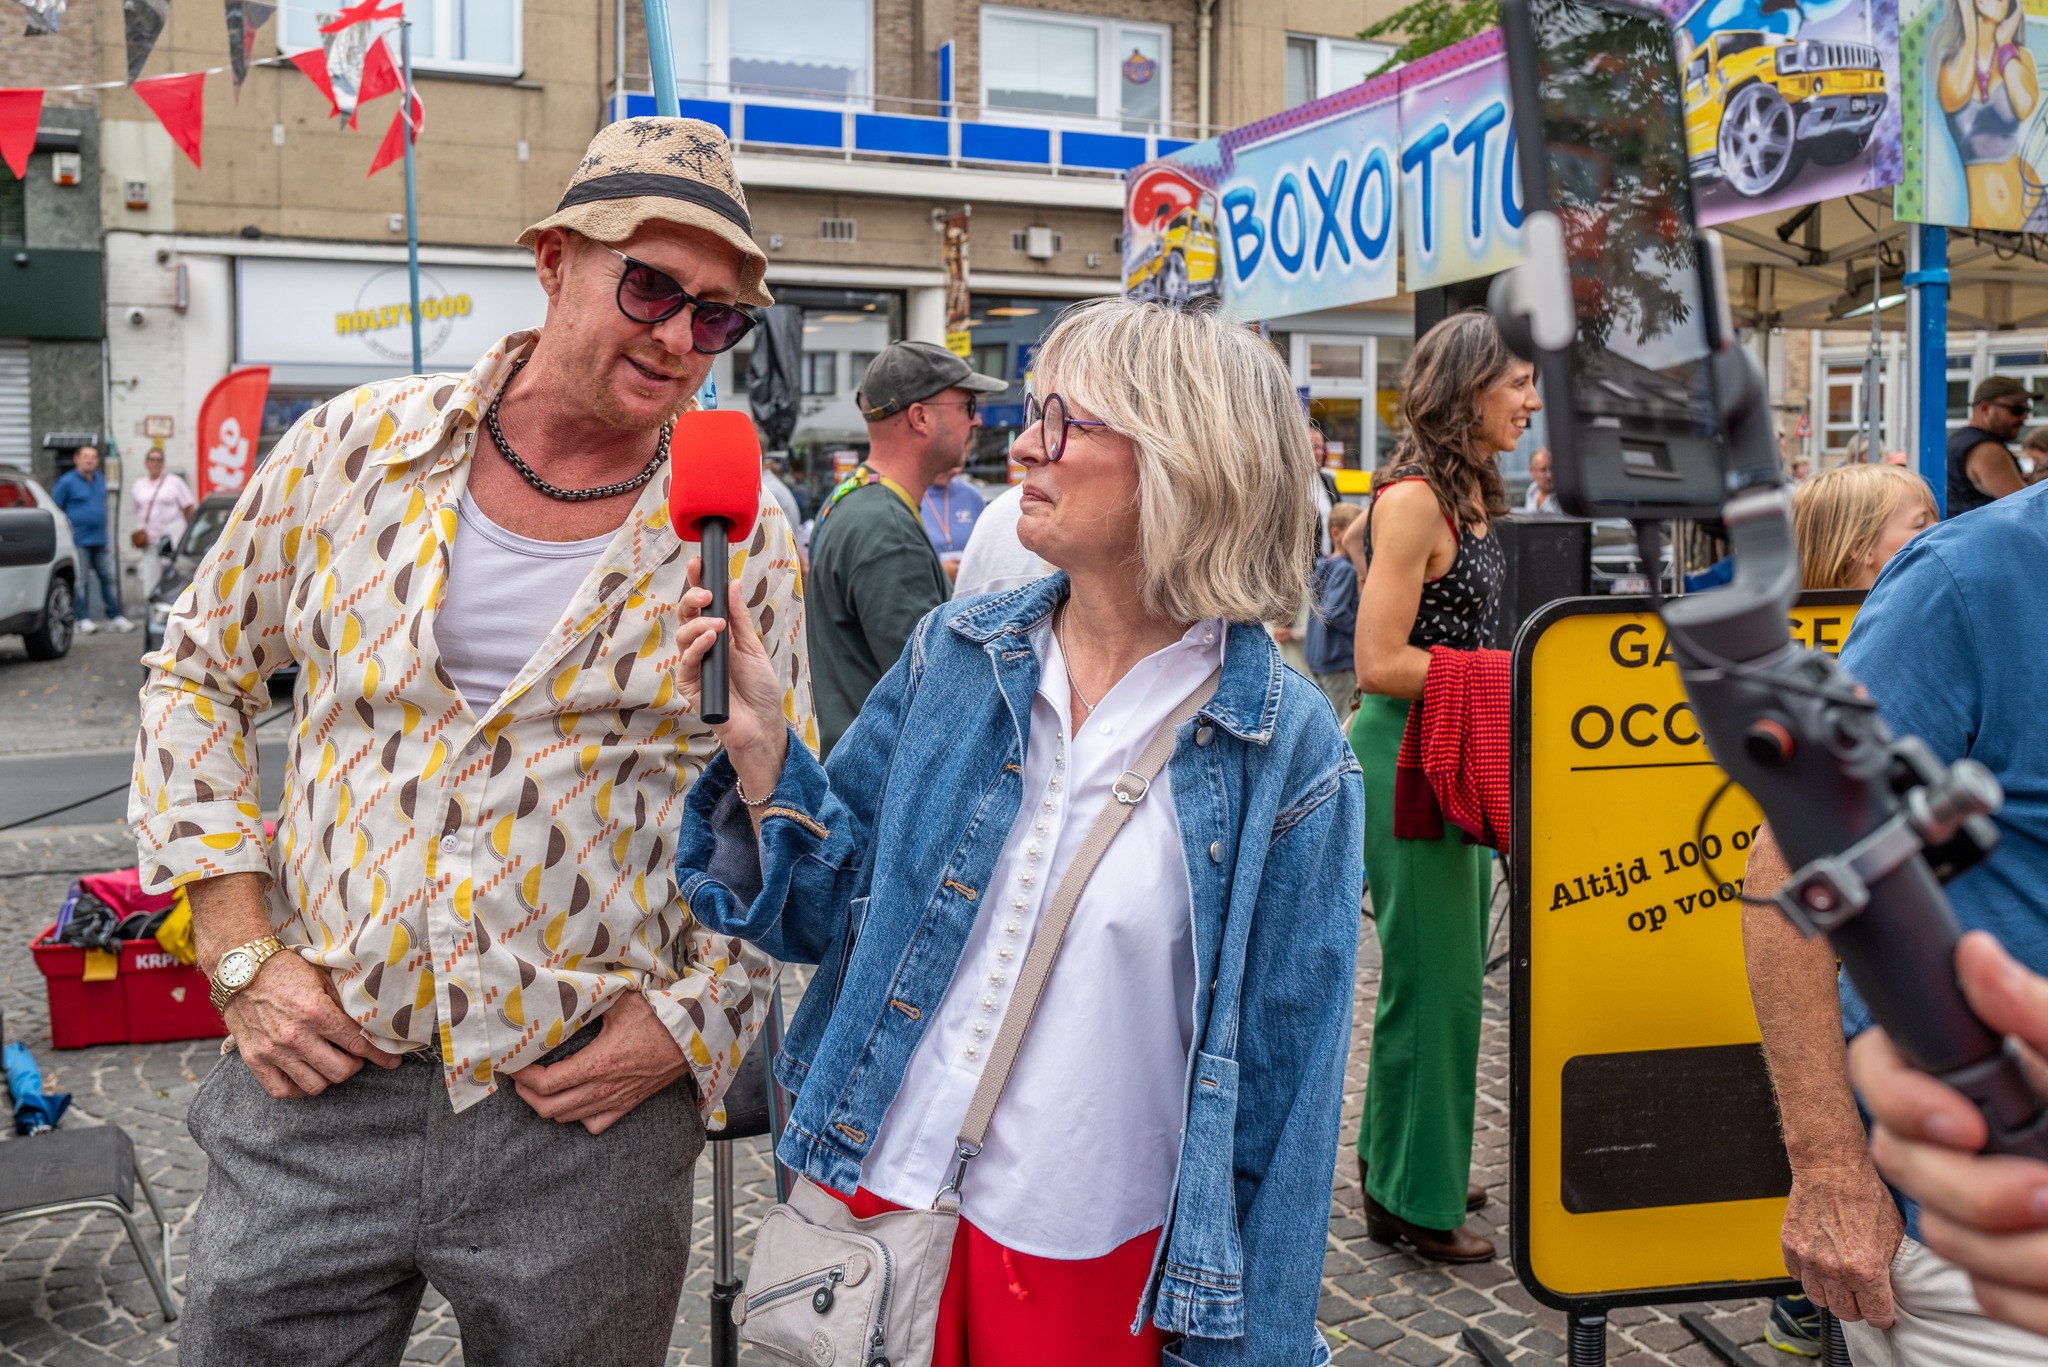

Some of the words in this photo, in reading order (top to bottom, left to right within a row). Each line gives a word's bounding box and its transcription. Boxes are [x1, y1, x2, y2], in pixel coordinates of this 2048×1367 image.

[336, 294, 472, 336] HOLLYWOOD
[208, 417, 250, 492] tto
[1609, 617, 1841, 669] GAE
[1571, 702, 1708, 750] OCC
[1549, 857, 1651, 912] Altijd
[1660, 834, 1722, 875] 100
[1628, 903, 1667, 933] op
